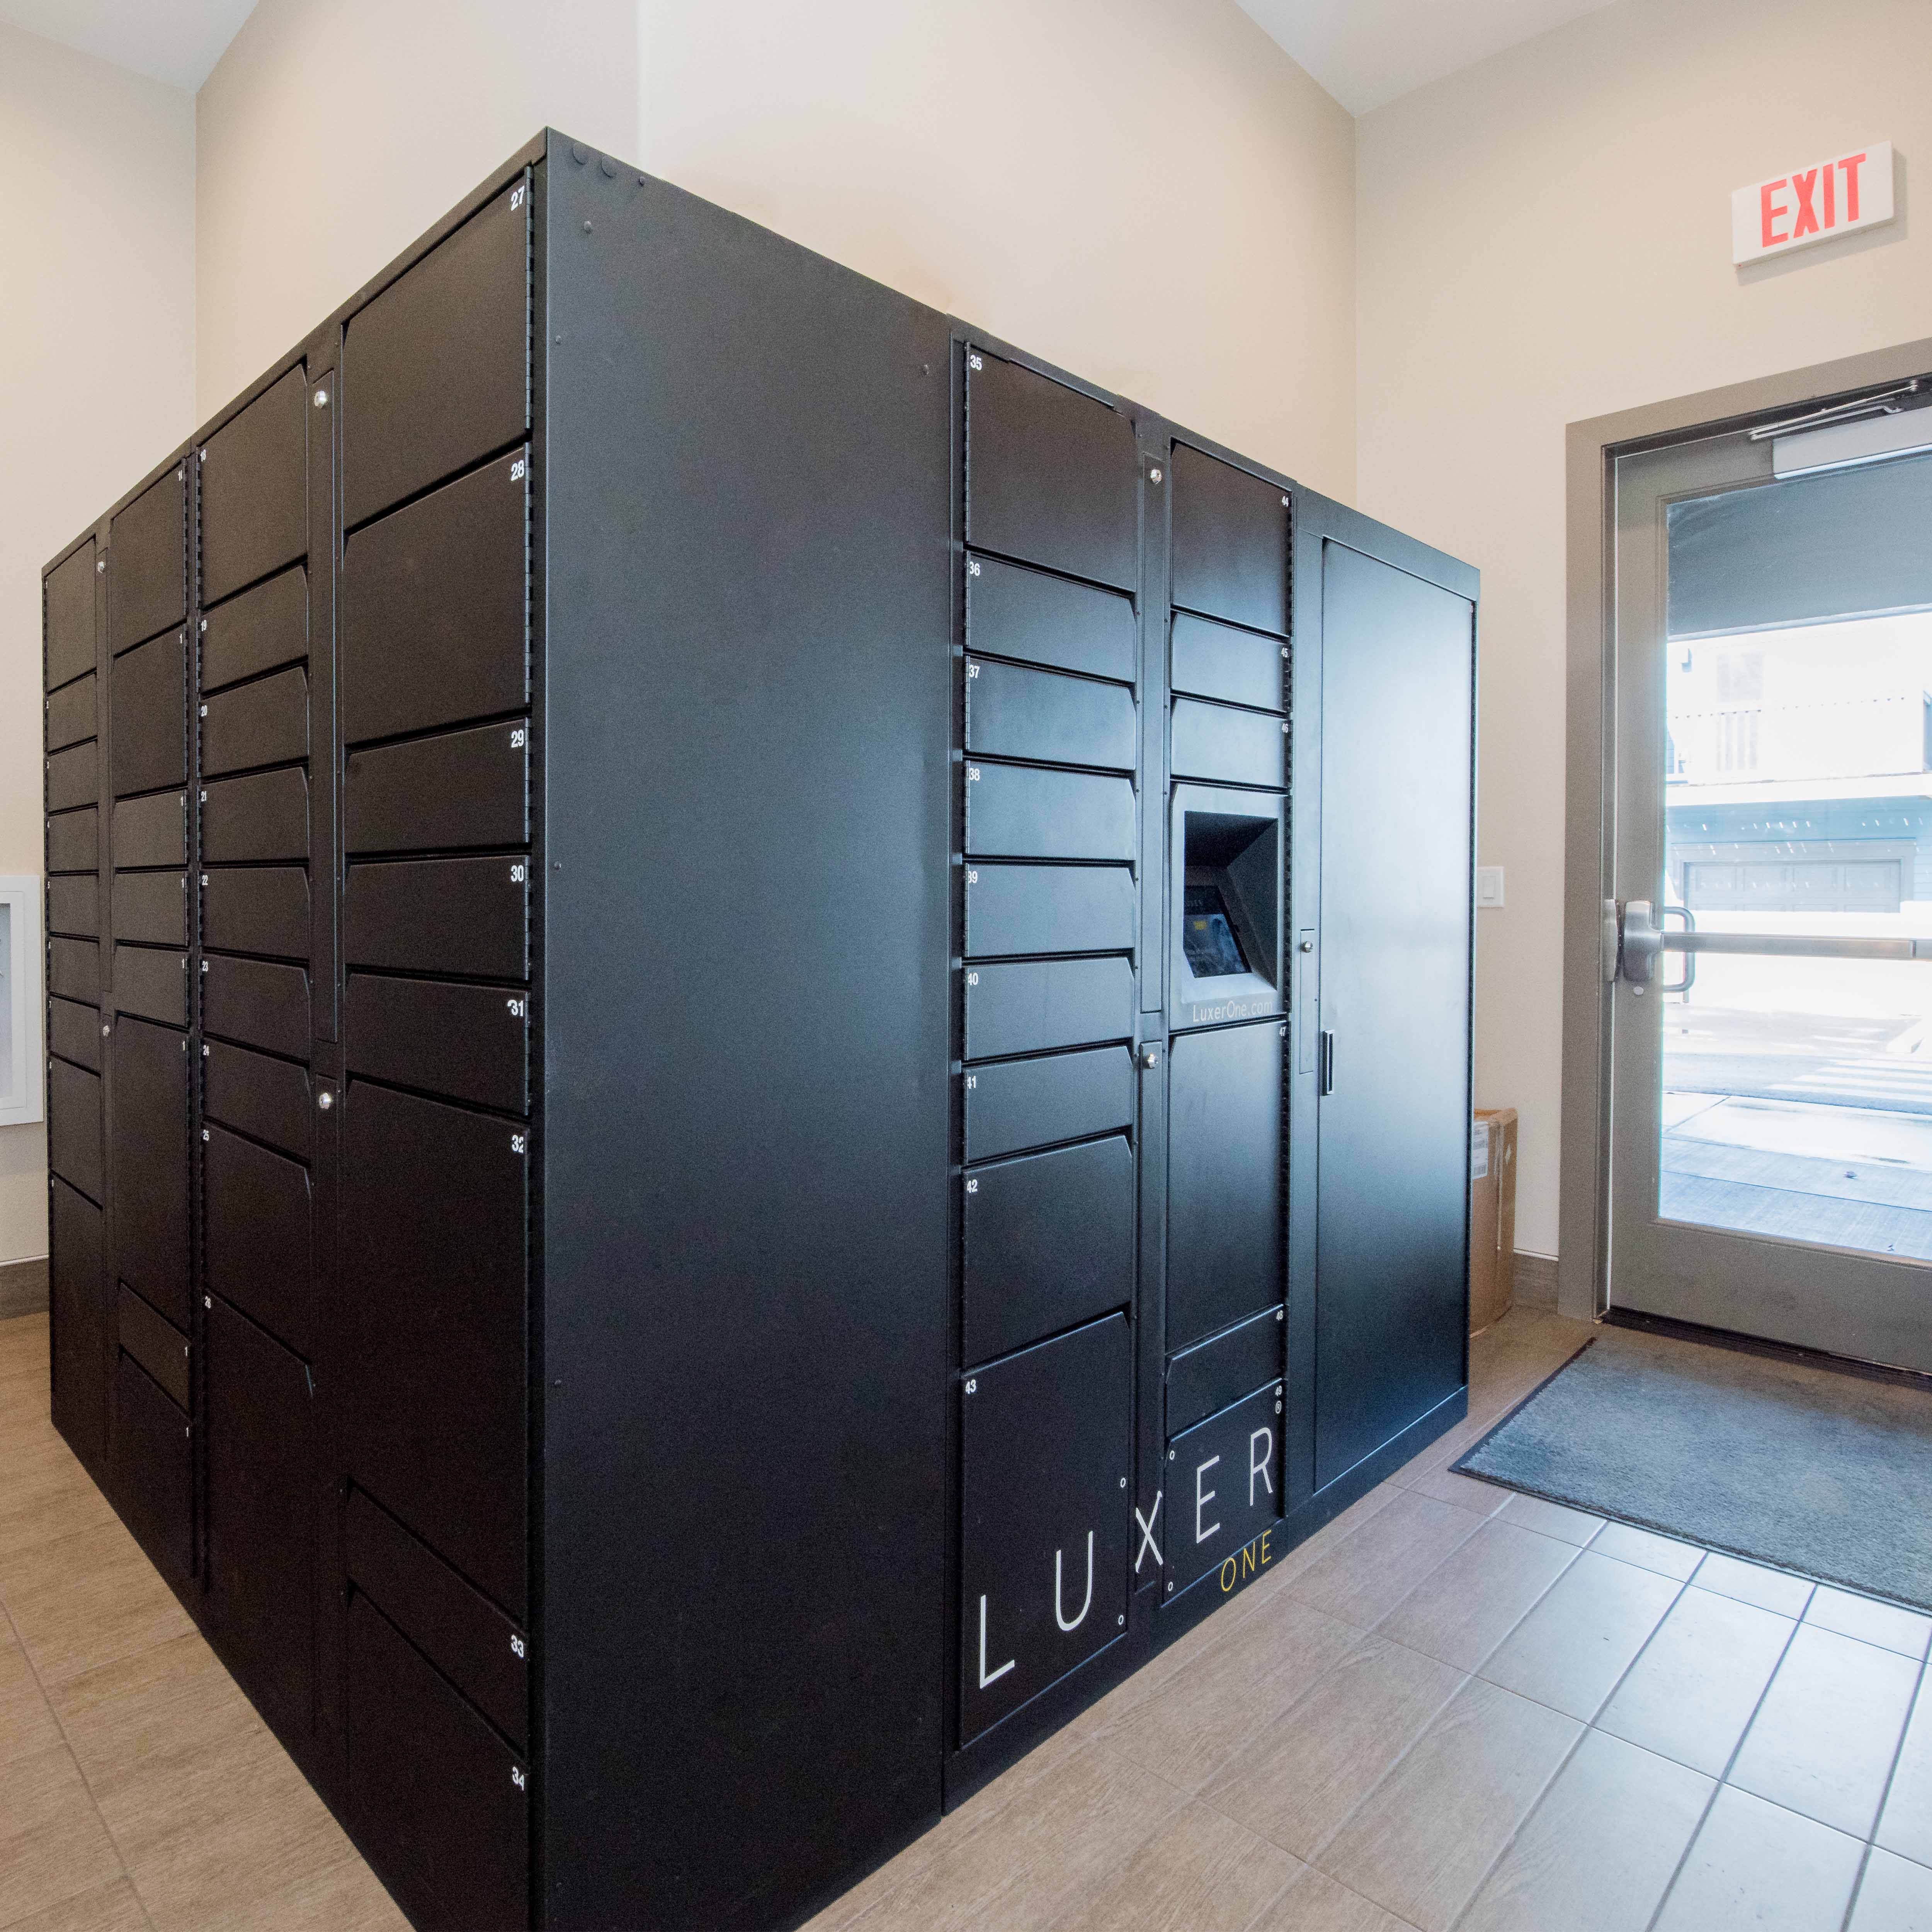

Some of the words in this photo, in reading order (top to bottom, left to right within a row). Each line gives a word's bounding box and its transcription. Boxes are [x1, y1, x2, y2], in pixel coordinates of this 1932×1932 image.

[511, 185, 525, 212] 27
[1761, 153, 1867, 248] EXIT
[970, 355, 982, 370] 35
[511, 460, 524, 481] 28
[1281, 495, 1289, 507] 44
[969, 561, 980, 576] 36
[201, 619, 207, 632] 19
[1281, 647, 1288, 658] 45
[969, 664, 980, 679] 37
[201, 705, 207, 717] 20
[1282, 723, 1288, 733] 46
[511, 730, 524, 748] 29
[969, 767, 980, 781] 38
[201, 791, 207, 802] 21
[202, 874, 208, 886] 22
[511, 865, 524, 882] 30
[202, 961, 209, 972] 23
[968, 973, 978, 985] 40
[508, 999, 523, 1016] 31
[1193, 1000, 1273, 1022] LuxerOne.com
[1279, 1027, 1286, 1036] 47
[203, 1045, 209, 1056] 24
[967, 1075, 976, 1089] 41
[203, 1129, 209, 1141] 25
[512, 1134, 524, 1153] 32
[967, 1179, 978, 1194] 42
[1276, 1310, 1283, 1321] 48
[965, 1379, 976, 1394] 43
[1275, 1385, 1282, 1396] 49
[980, 1427, 1273, 1689] LUXER
[1221, 1530, 1271, 1592] ONE
[511, 1635, 524, 1658] 33
[512, 1767, 524, 1791] 34
